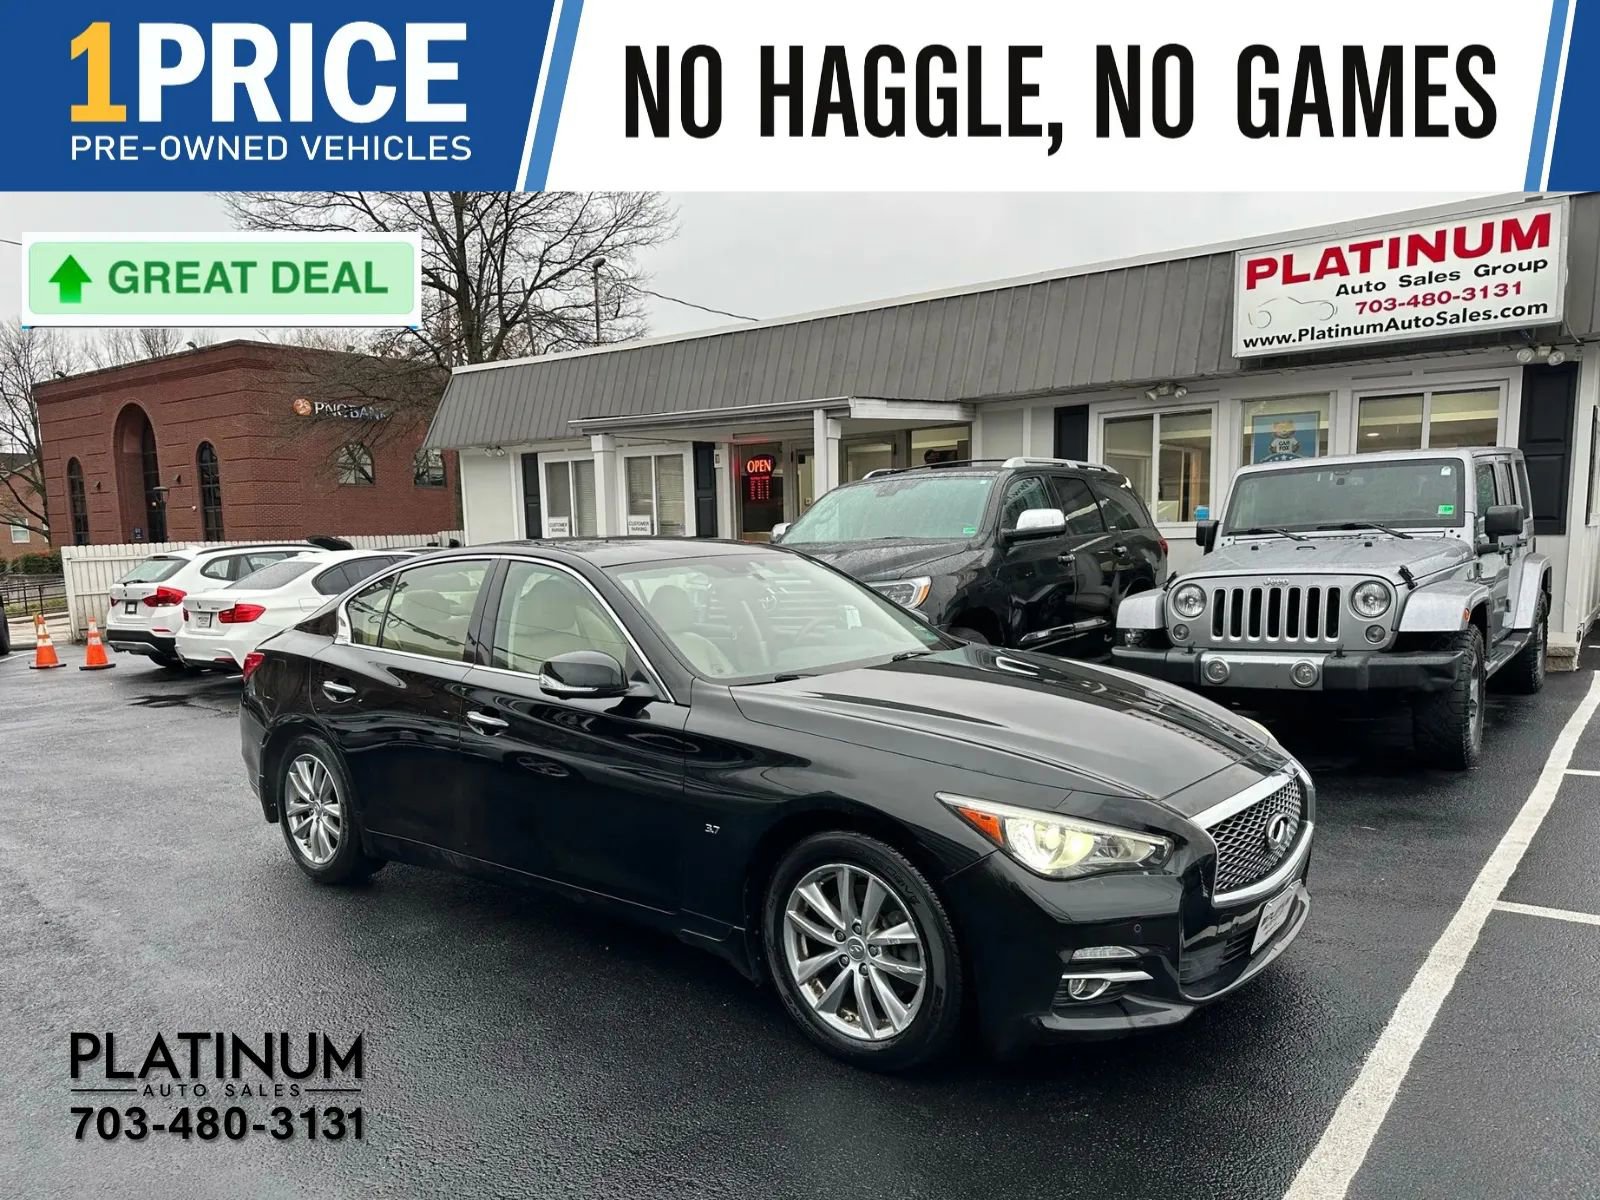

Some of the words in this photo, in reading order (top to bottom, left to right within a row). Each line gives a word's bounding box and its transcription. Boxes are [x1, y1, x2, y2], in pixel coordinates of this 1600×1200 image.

[1246, 212, 1551, 290] PLATINUM
[1336, 280, 1387, 297] Auto
[1399, 269, 1461, 288] Sales
[1473, 259, 1549, 277] Group
[1355, 281, 1523, 315] 703-480-3131
[1243, 301, 1549, 348] www.PlatinumAutoSales.com
[747, 459, 771, 473] OPEN
